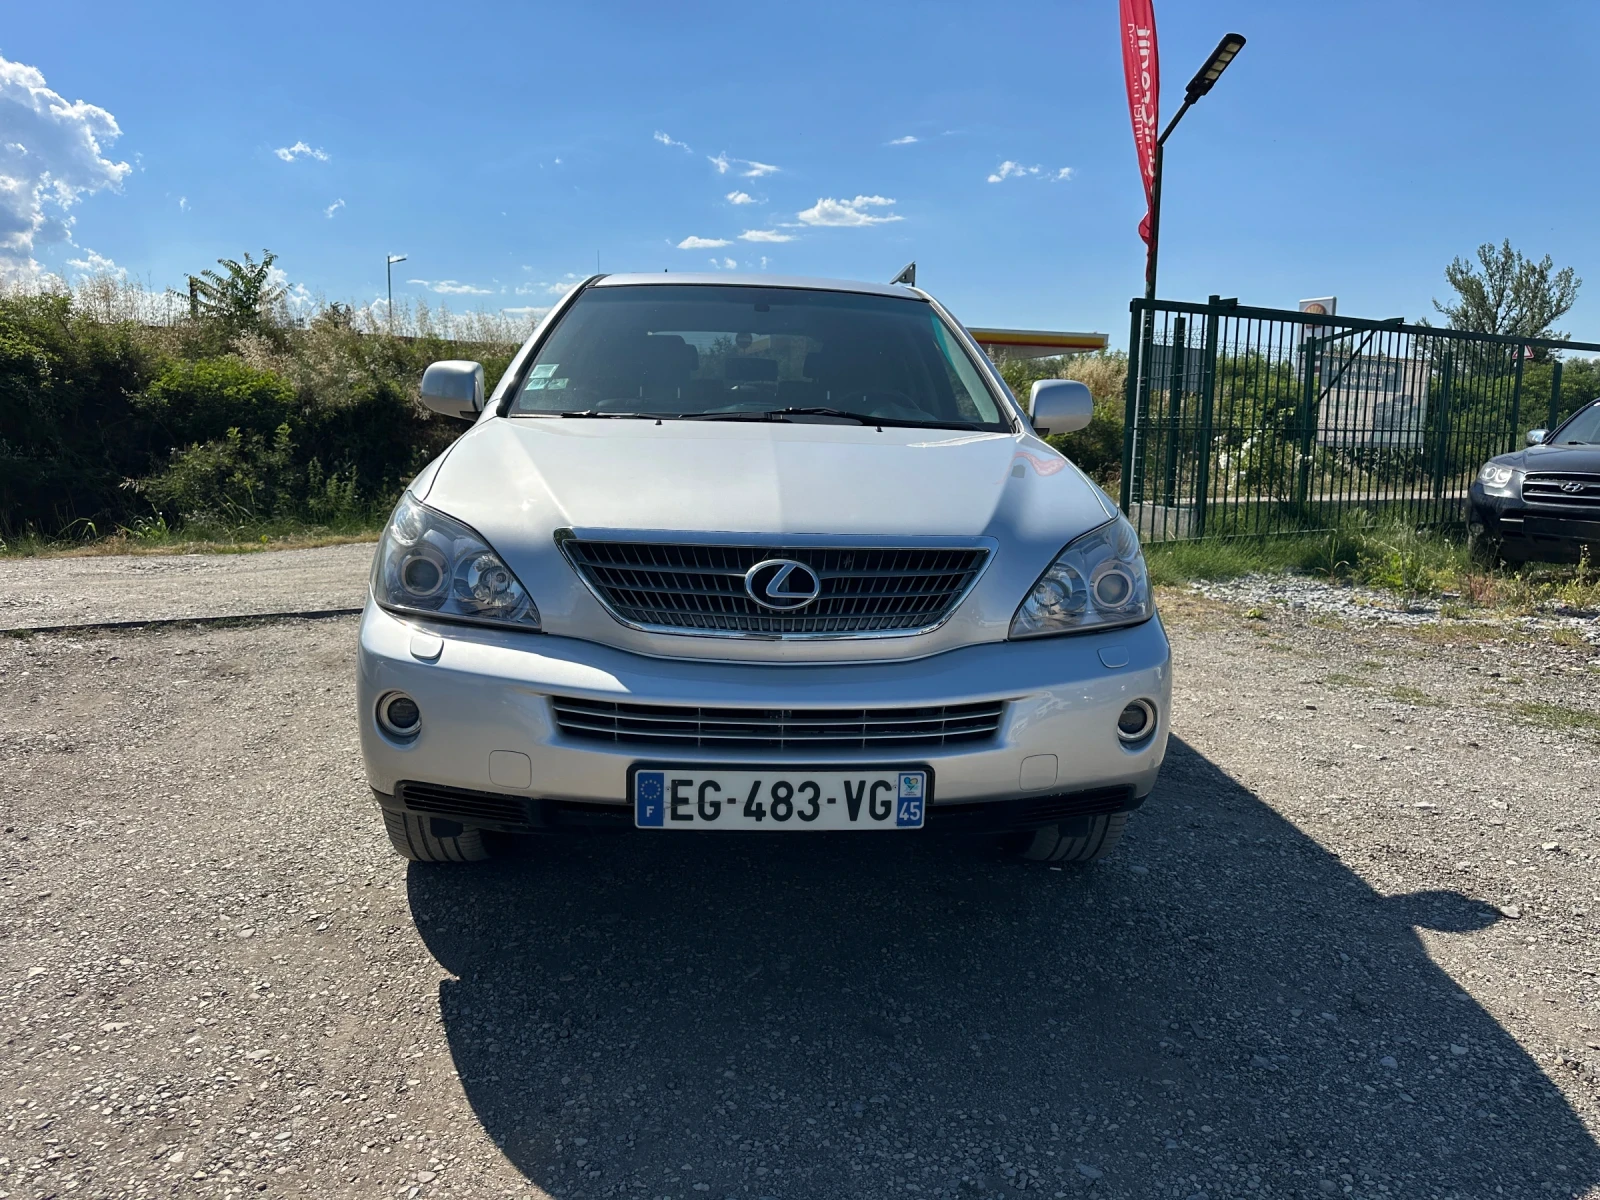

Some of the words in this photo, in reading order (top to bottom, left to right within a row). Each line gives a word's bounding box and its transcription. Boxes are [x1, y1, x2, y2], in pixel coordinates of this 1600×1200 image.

[670, 779, 893, 822] EG-483-VG
[646, 805, 655, 818] F
[899, 801, 921, 821] 45
